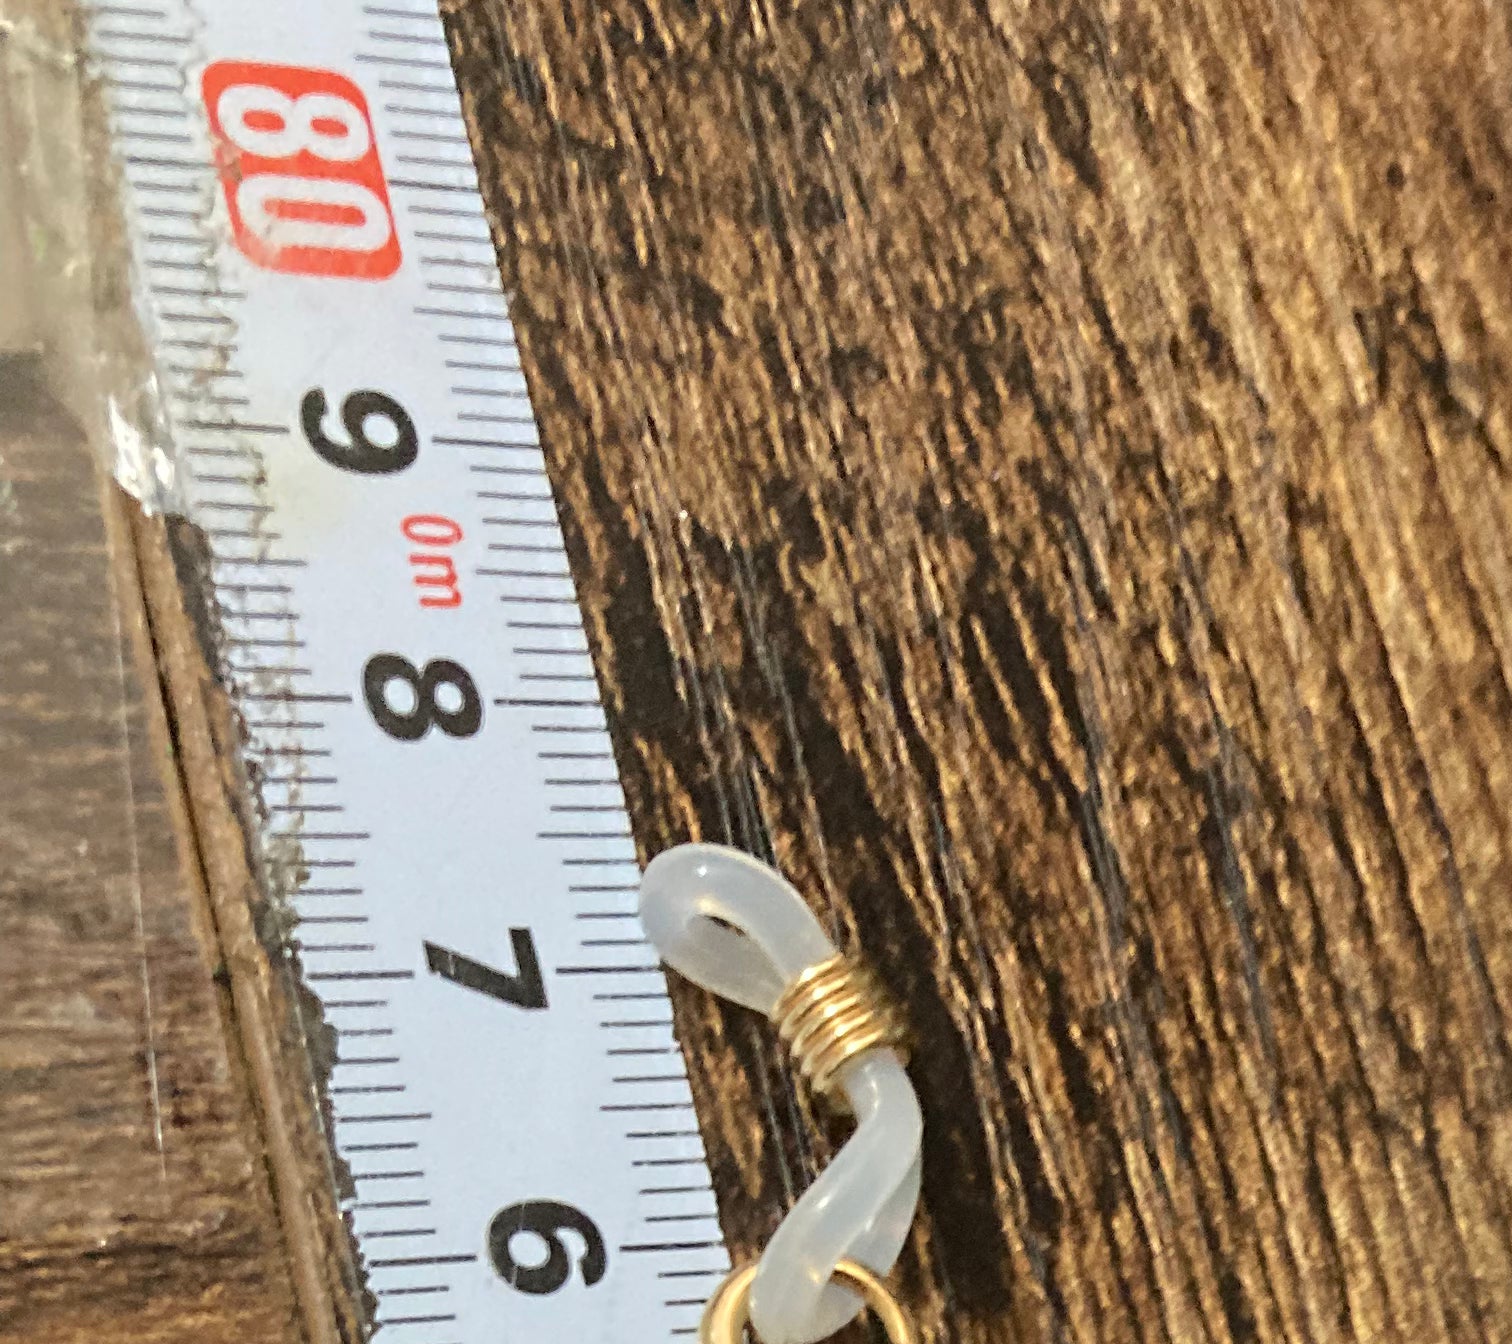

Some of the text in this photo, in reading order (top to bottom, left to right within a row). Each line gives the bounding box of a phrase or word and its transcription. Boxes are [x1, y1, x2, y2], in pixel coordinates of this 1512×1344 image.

[217, 83, 392, 252] 80
[301, 387, 419, 474] 9
[401, 514, 462, 607] 0m
[361, 652, 485, 741] 8
[422, 927, 549, 1010] 7
[487, 1199, 607, 1297] 6
